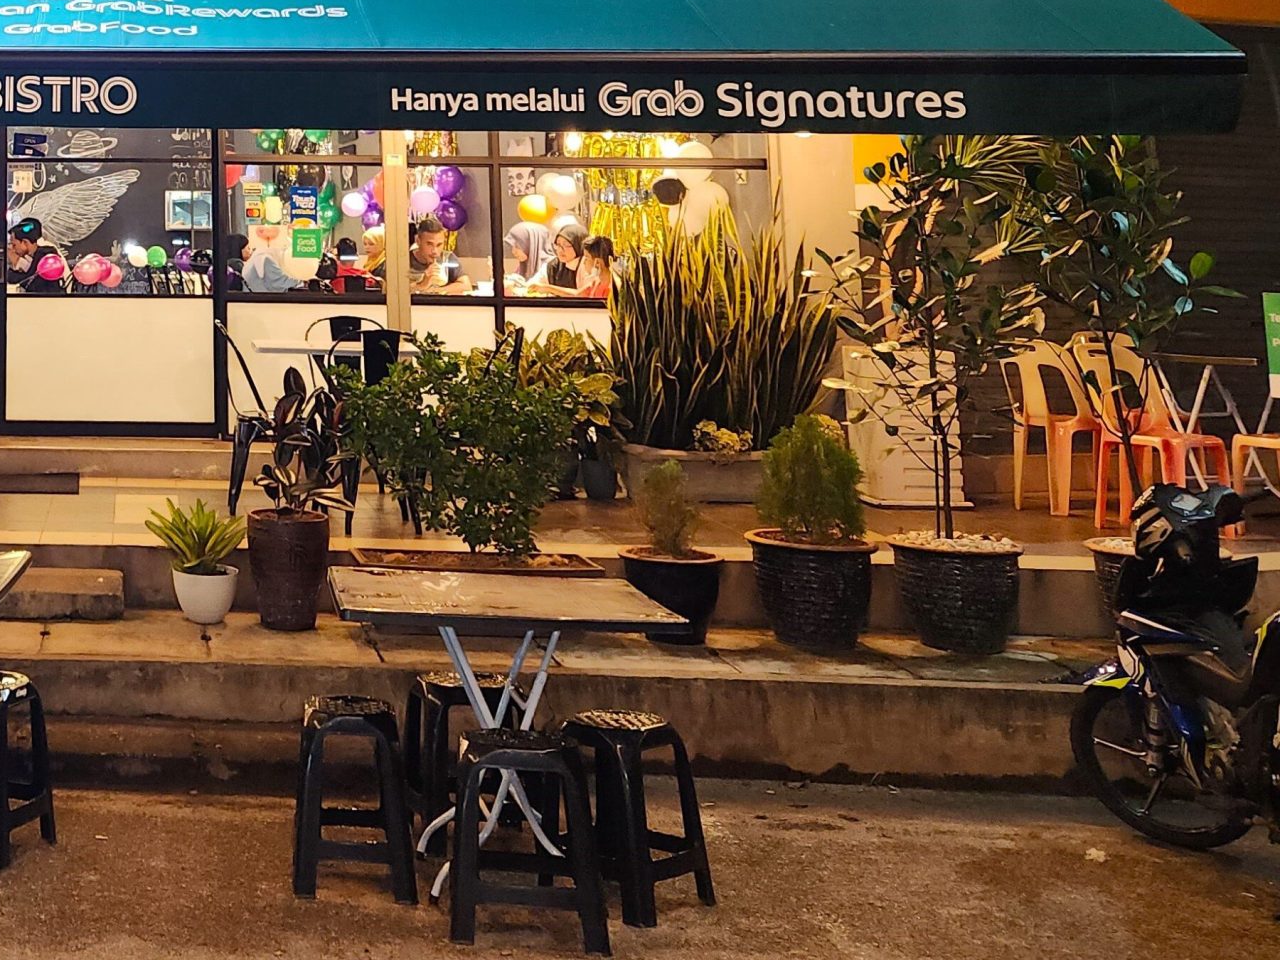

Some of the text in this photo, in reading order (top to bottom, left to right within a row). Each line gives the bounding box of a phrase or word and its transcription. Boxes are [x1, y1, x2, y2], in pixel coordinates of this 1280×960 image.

[4, 21, 198, 36] GrabFood
[391, 80, 968, 127] Hanya melalui Grab Signatures
